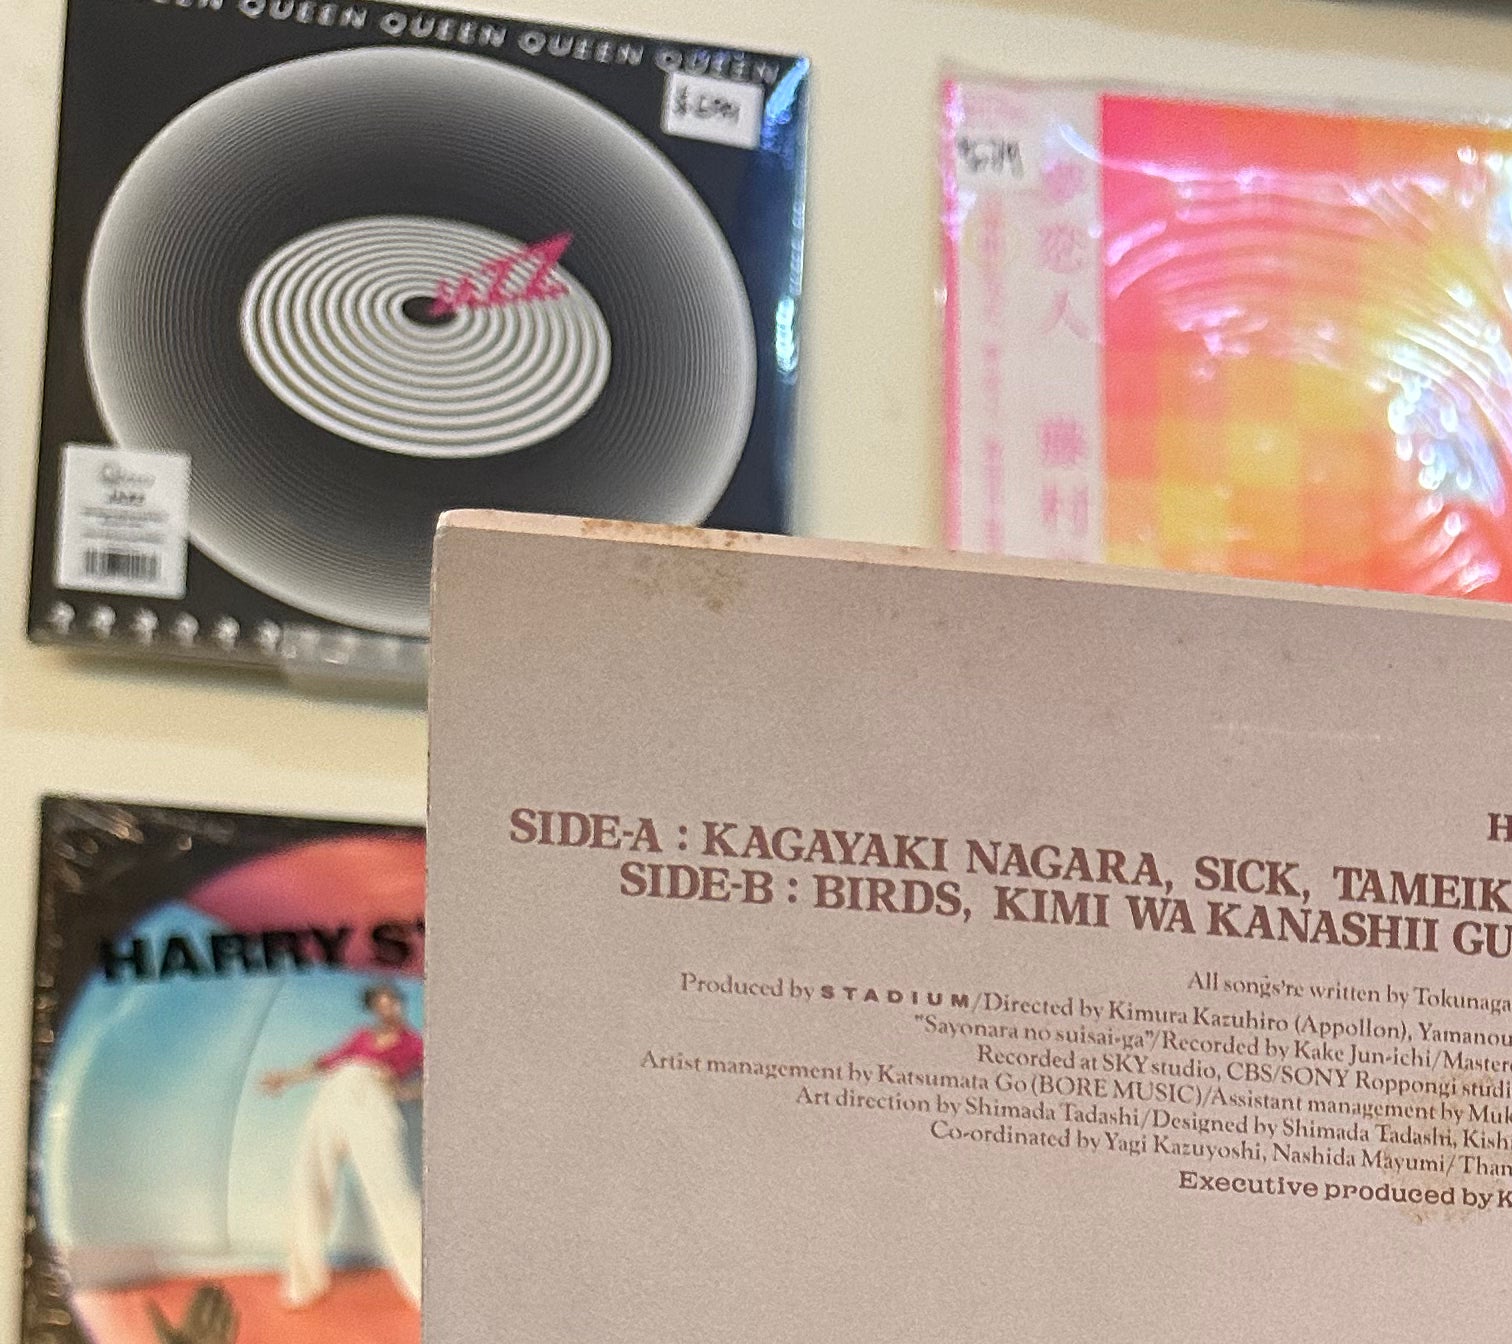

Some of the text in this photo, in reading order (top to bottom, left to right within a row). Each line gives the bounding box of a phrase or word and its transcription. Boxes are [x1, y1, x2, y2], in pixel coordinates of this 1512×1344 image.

[379, 11, 508, 47] QUEEN
[518, 29, 645, 66] QUEEN
[509, 806, 663, 854] SIDE-A
[700, 819, 949, 872] KAGAYAKI
[964, 838, 1173, 896] NAGARA,
[1193, 854, 1311, 905] SICK,
[618, 860, 774, 905] SIDE-B
[811, 873, 972, 924] BIRDS,
[992, 883, 1110, 928] KIMI
[1123, 893, 1197, 935] WA
[1204, 899, 1439, 953] KANASHII
[100, 914, 426, 985] HARRY S
[679, 970, 784, 998] Produced
[788, 976, 812, 1003] by
[1078, 996, 1104, 1024] by
[1107, 998, 1188, 1025] Kimura
[1191, 1004, 1289, 1032] Kazuhiro
[1292, 1012, 1413, 1043] (Appollon),
[1186, 969, 1219, 992] All
[1308, 979, 1381, 1003] written
[1385, 982, 1410, 1010] by
[1411, 984, 1512, 1016] Tokunaga
[976, 1042, 1076, 1070] Recorded
[1078, 1055, 1097, 1072] at
[1101, 1051, 1149, 1075] SKY
[1149, 1056, 1222, 1083] studio,
[1354, 1068, 1457, 1098] Roppongi
[1177, 1168, 1319, 1198] Executive
[1322, 1181, 1456, 1206] produced
[1460, 1185, 1494, 1213] by
